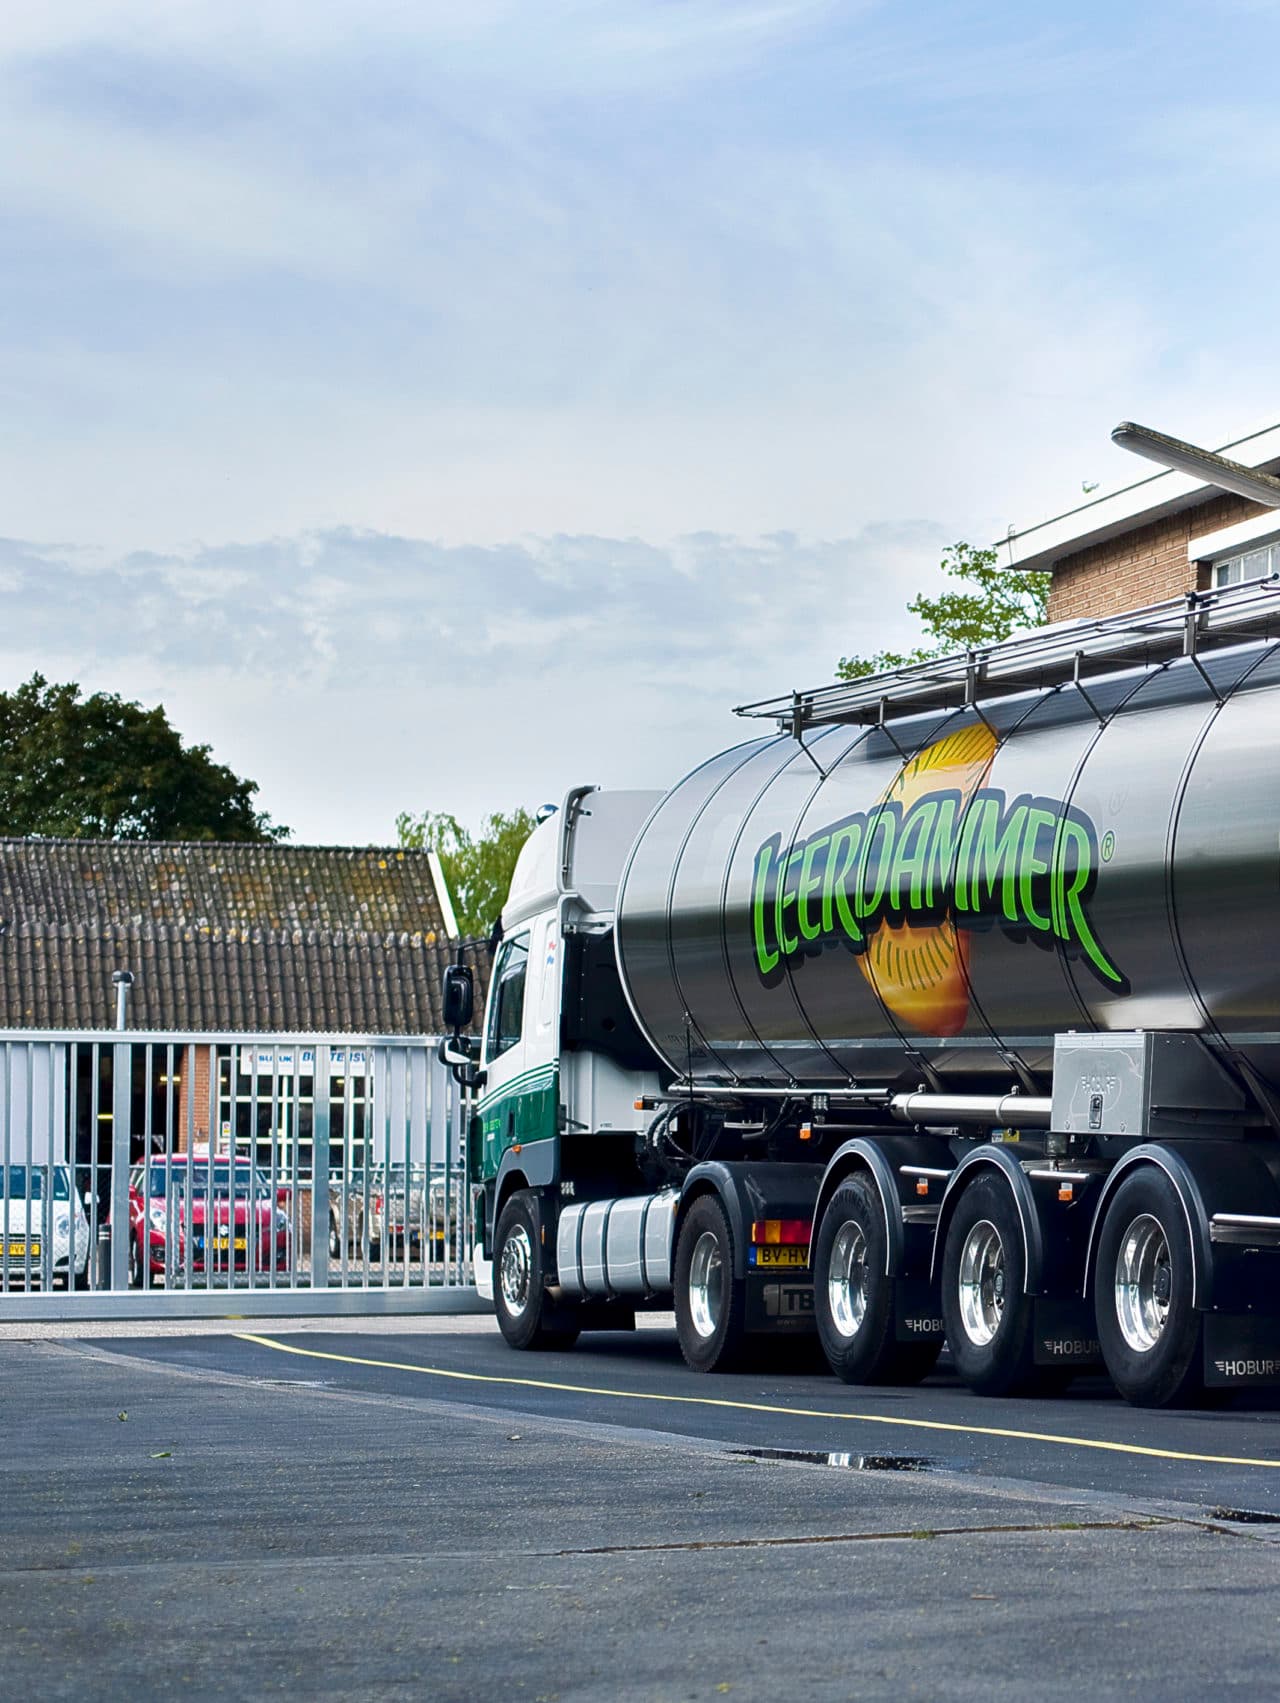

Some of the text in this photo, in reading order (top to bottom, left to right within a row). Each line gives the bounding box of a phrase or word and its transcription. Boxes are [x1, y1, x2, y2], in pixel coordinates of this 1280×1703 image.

[753, 794, 1125, 985] LEERDAMMER
[258, 1054, 297, 1063] SUUK
[913, 1319, 944, 1332] HOB
[1225, 1360, 1274, 1376] HOBUR
